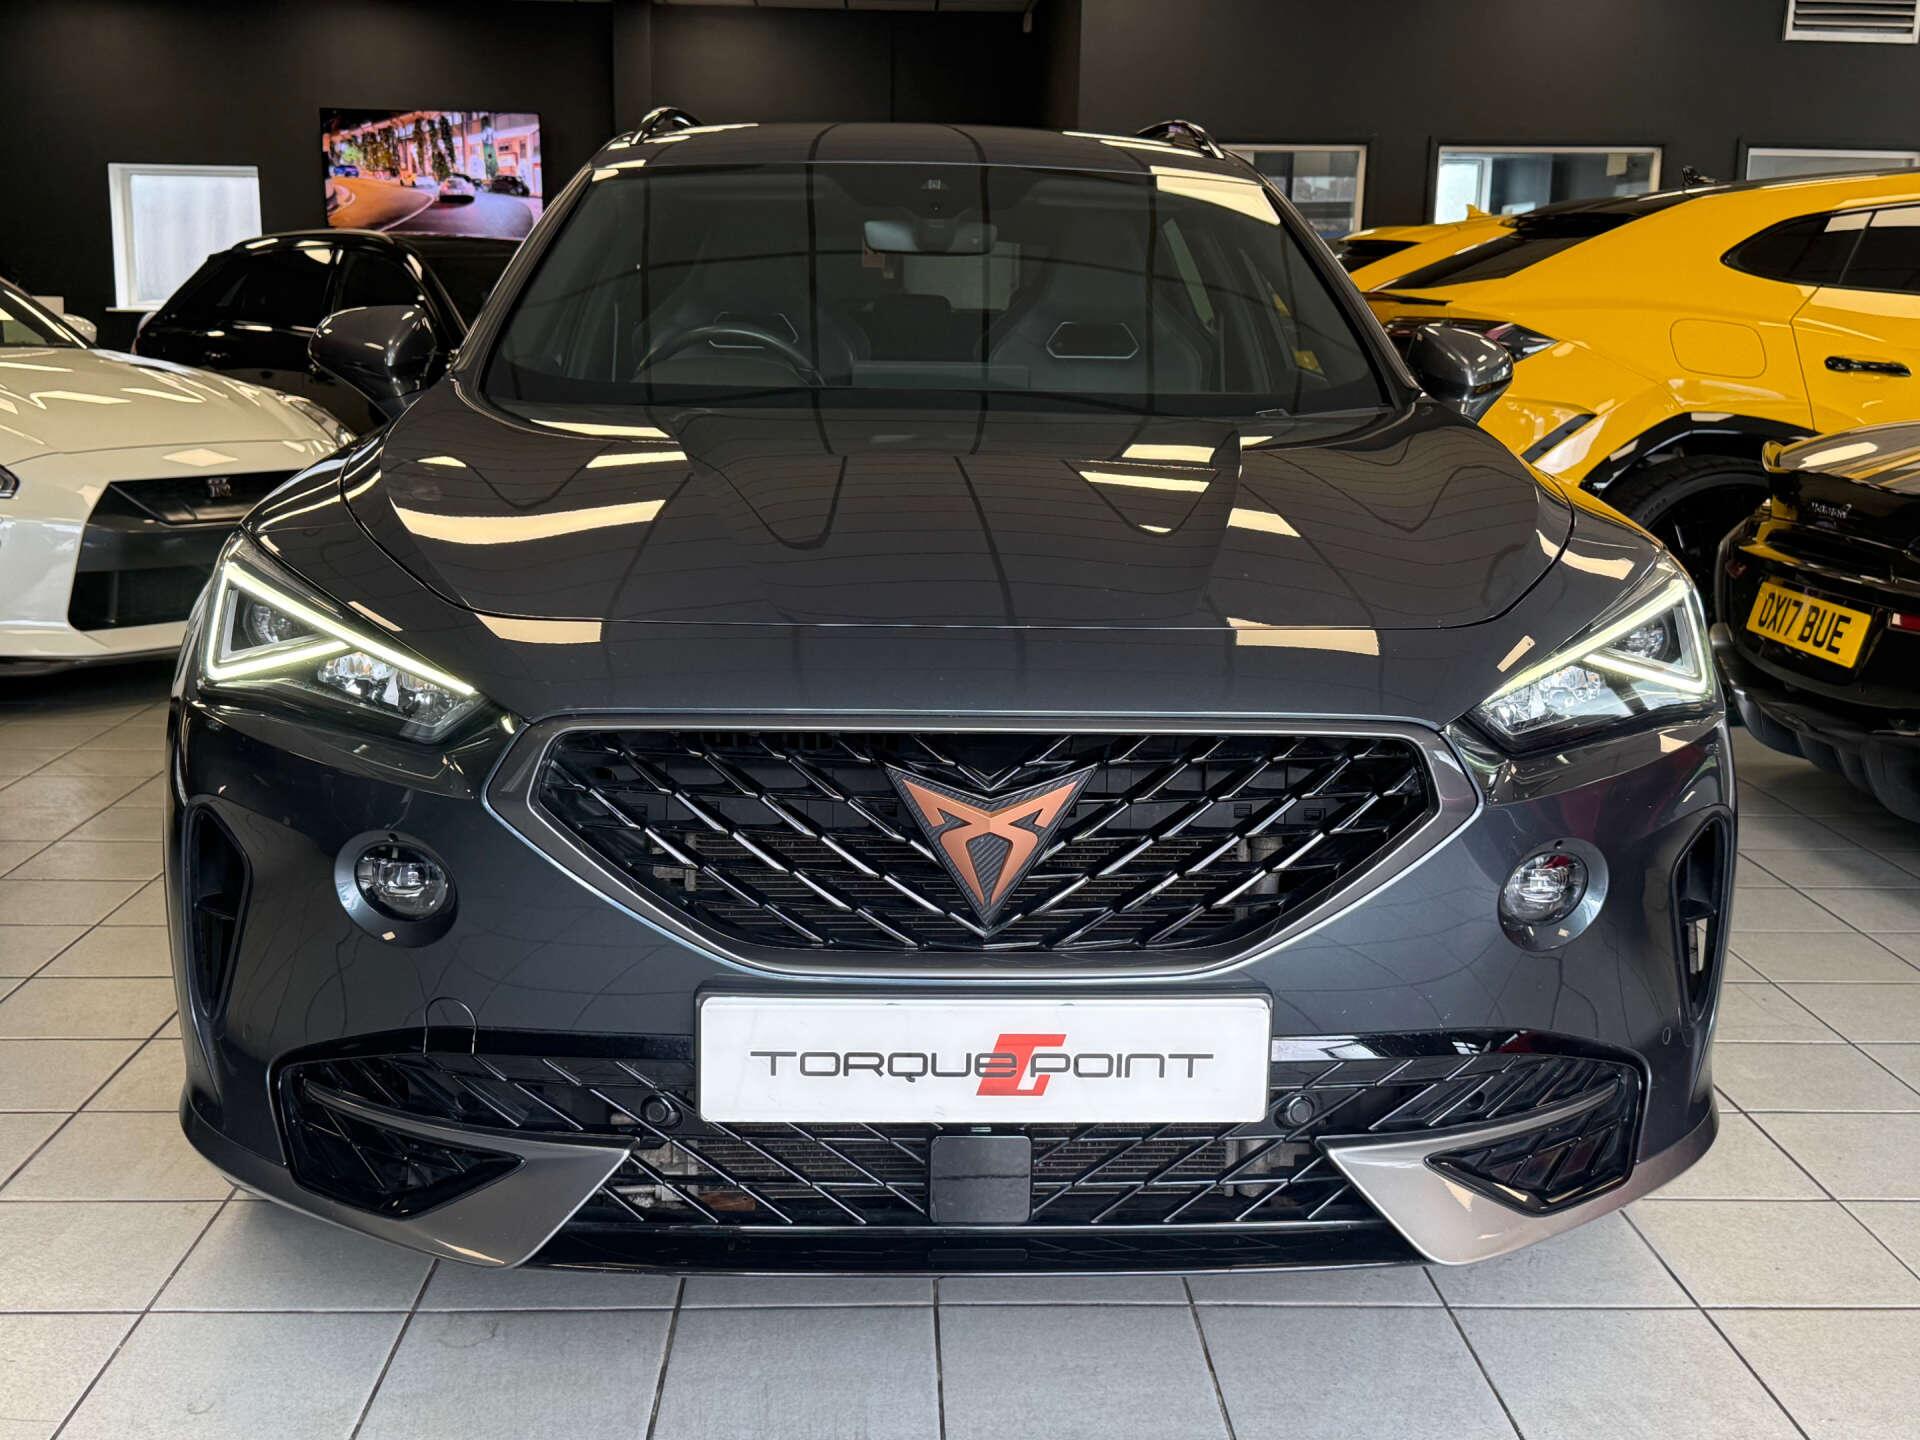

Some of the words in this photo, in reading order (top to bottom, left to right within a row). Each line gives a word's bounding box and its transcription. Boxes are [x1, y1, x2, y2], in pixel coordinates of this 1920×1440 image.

[1797, 605, 1852, 654] BUE
[750, 1051, 1017, 1083] TORQUE
[1030, 1053, 1214, 1078] POINT
